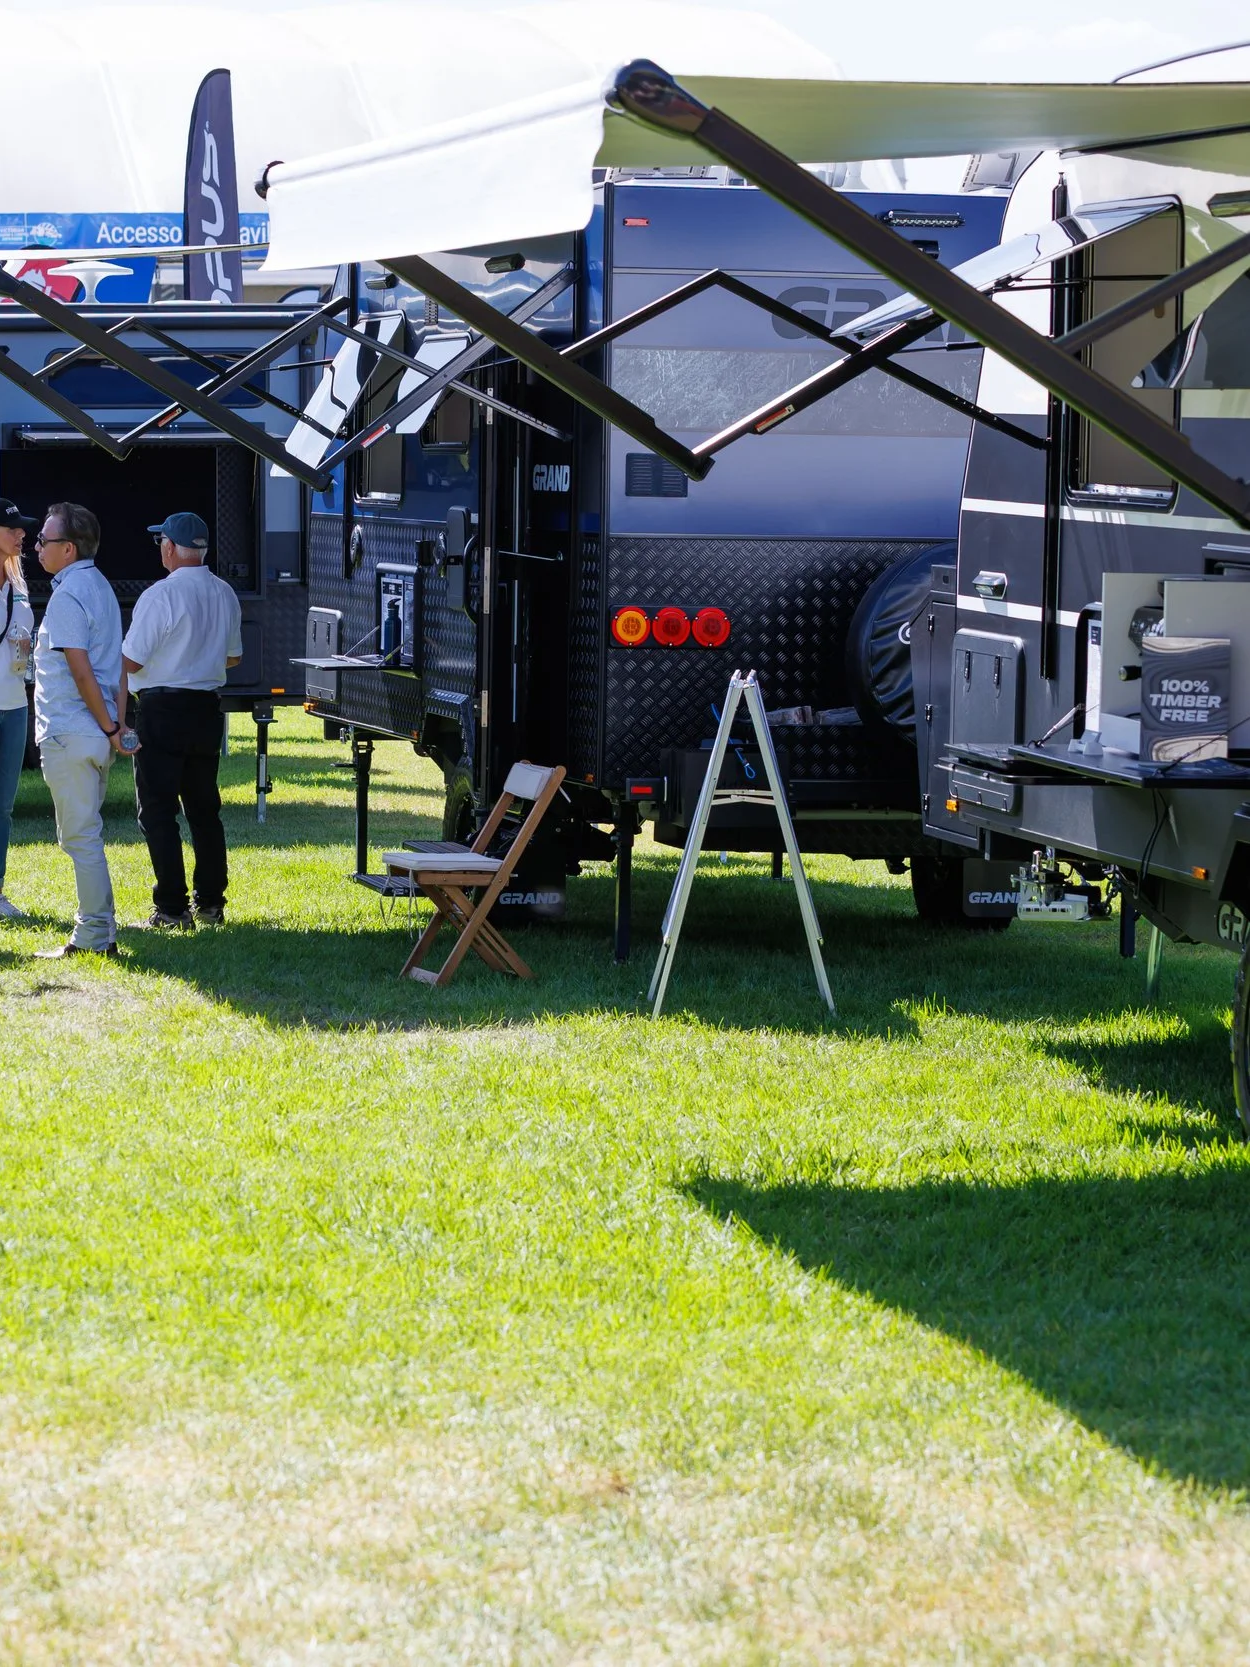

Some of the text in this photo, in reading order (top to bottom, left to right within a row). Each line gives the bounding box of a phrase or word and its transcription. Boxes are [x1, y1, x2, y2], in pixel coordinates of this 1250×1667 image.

[96, 222, 183, 244] Accesso
[533, 464, 571, 492] GRAND
[1161, 679, 1210, 693] 100%
[1149, 694, 1222, 708] TIMBER
[1160, 708, 1210, 722] FREE
[499, 892, 561, 905] GRAND
